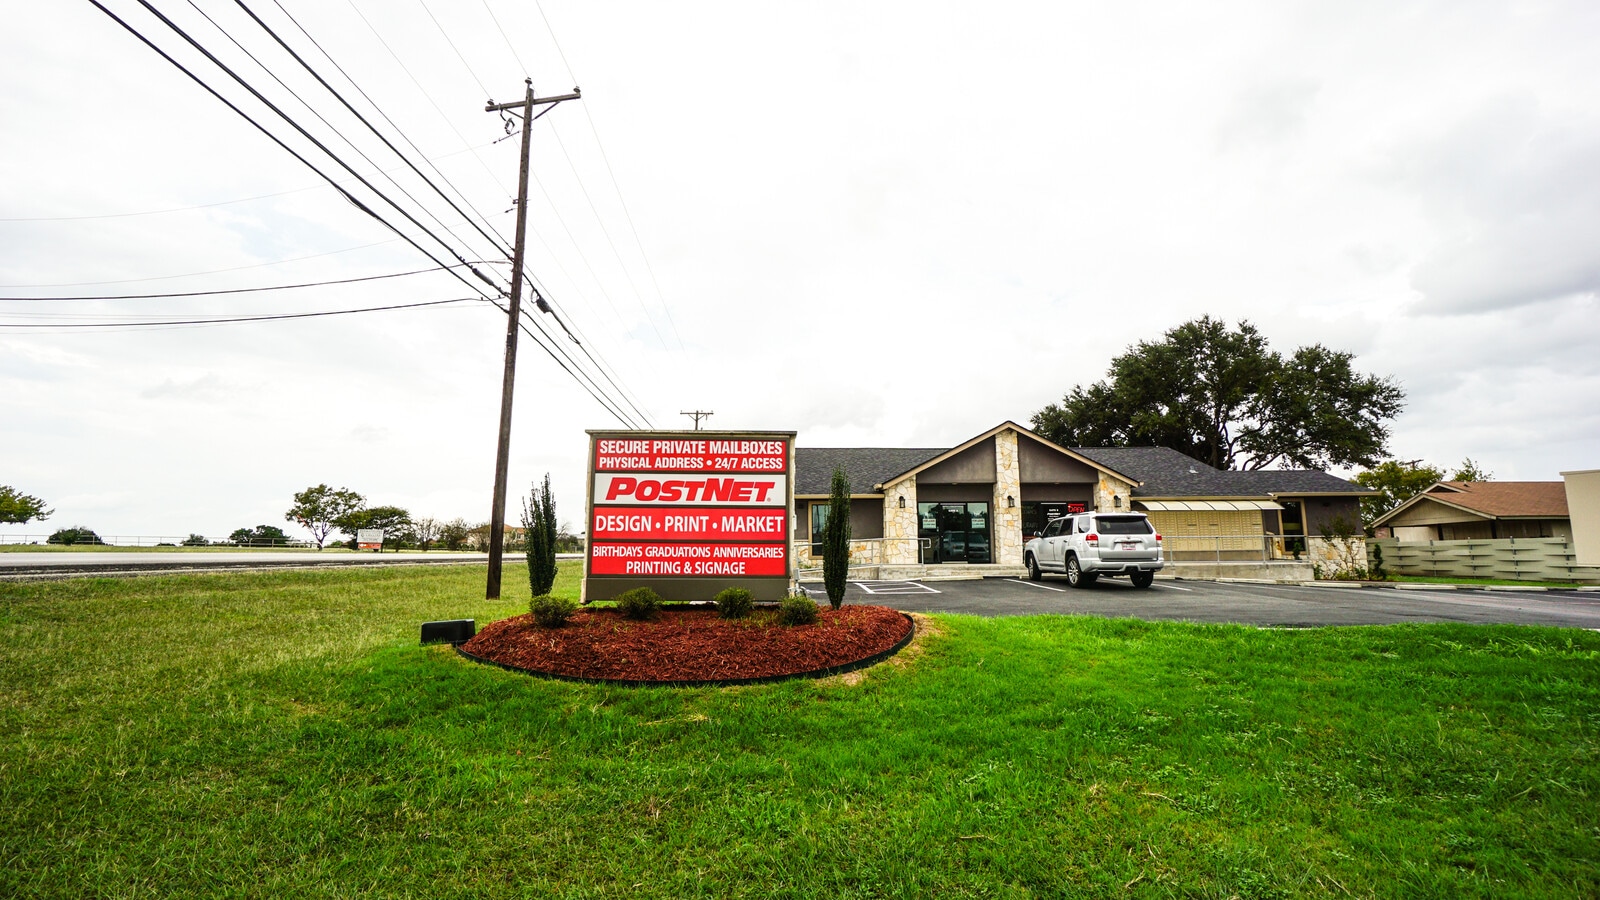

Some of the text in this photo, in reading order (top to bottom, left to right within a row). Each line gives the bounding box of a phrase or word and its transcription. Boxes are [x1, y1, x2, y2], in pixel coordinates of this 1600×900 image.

[600, 441, 782, 454] SECURE PRIVATE MAILBOXES
[599, 457, 782, 469] PHYSICAL ADDRESS 24/7 ACCESS
[596, 516, 783, 532] DESIGN PRINT MARKET
[593, 546, 783, 558] BIRTHDAYS GRADUATIONS ANNIVERSARIES
[626, 562, 745, 574] PRINTING & SIGNAGE
